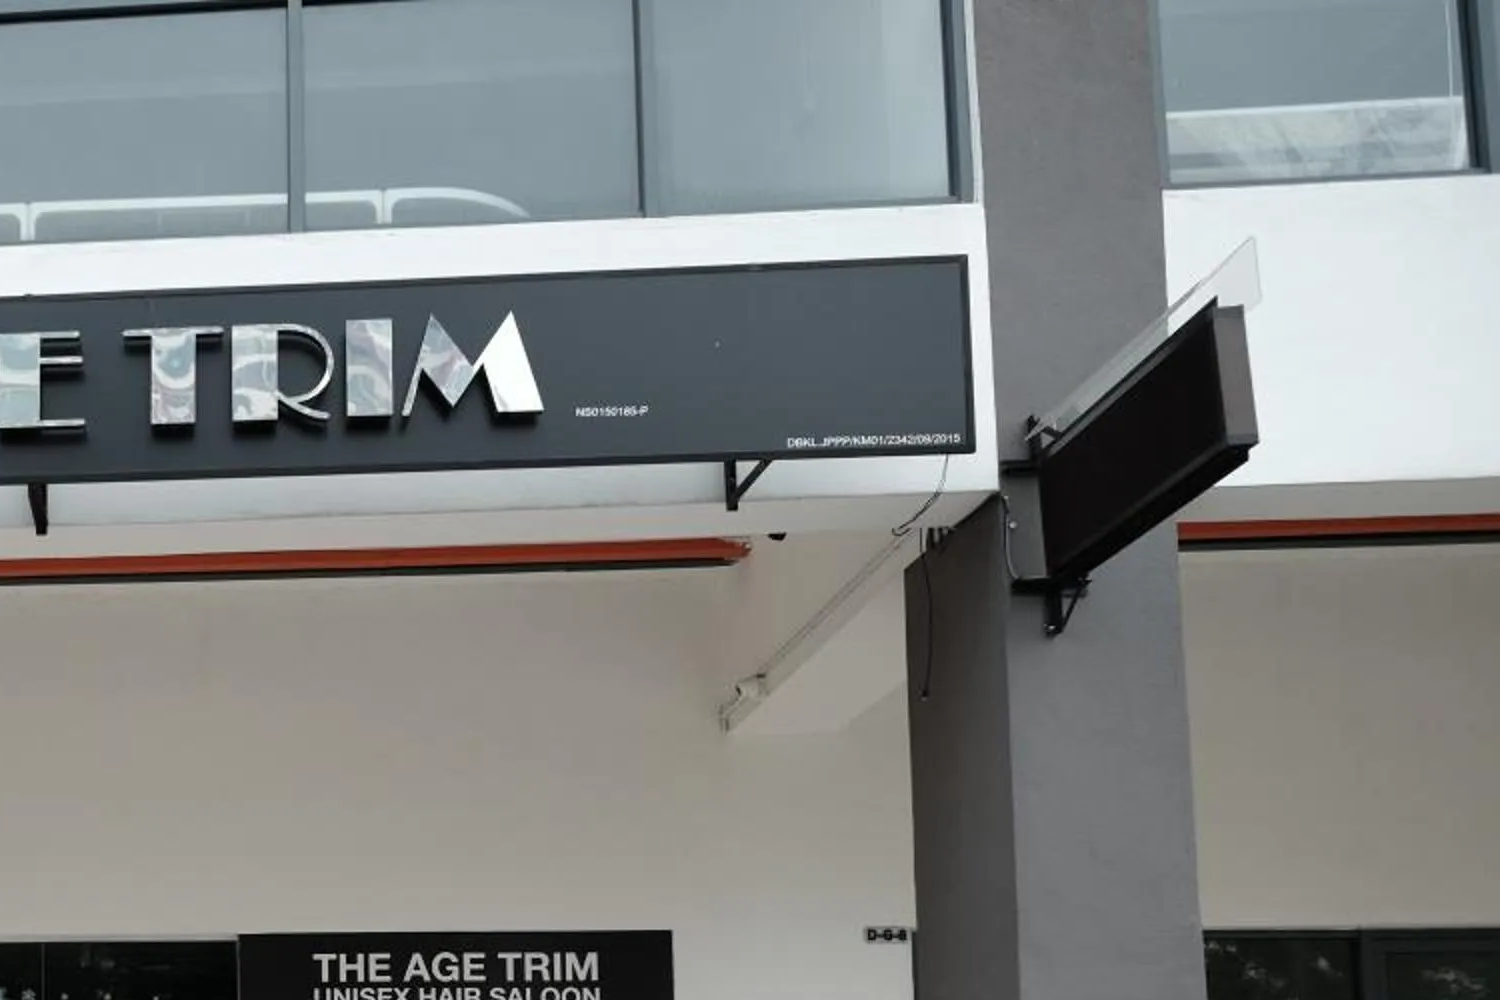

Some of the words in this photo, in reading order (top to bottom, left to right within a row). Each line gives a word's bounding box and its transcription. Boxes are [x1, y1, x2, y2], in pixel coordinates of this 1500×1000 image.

[122, 310, 545, 427] TRIM
[312, 952, 392, 983] THE
[403, 951, 487, 982] AGE
[498, 951, 600, 982] TRIM
